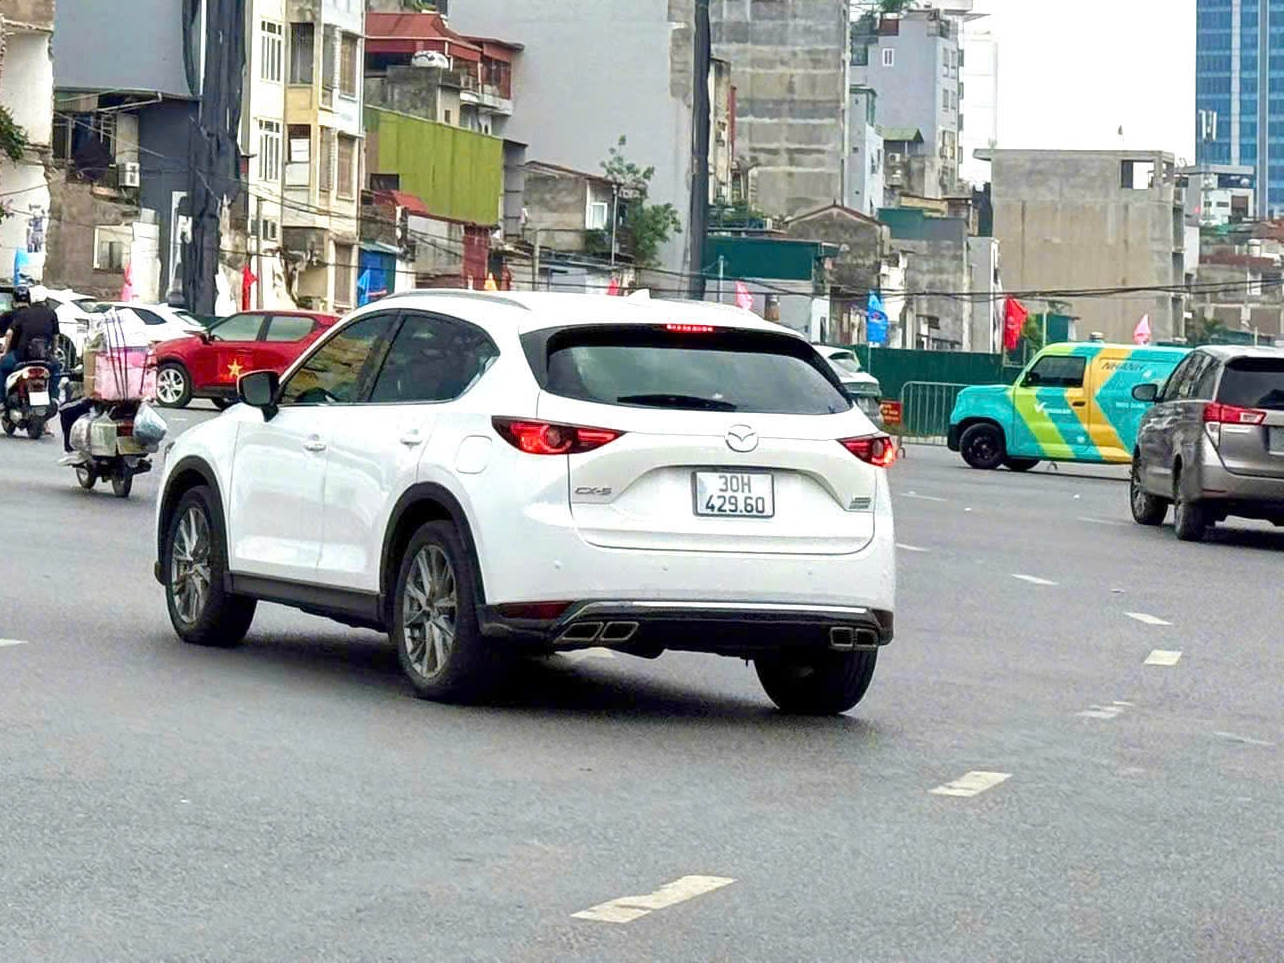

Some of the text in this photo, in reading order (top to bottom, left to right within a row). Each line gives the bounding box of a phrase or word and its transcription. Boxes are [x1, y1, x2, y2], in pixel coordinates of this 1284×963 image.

[575, 487, 613, 496] CX-5
[718, 475, 752, 494] 30H
[705, 494, 765, 514] 429.60
